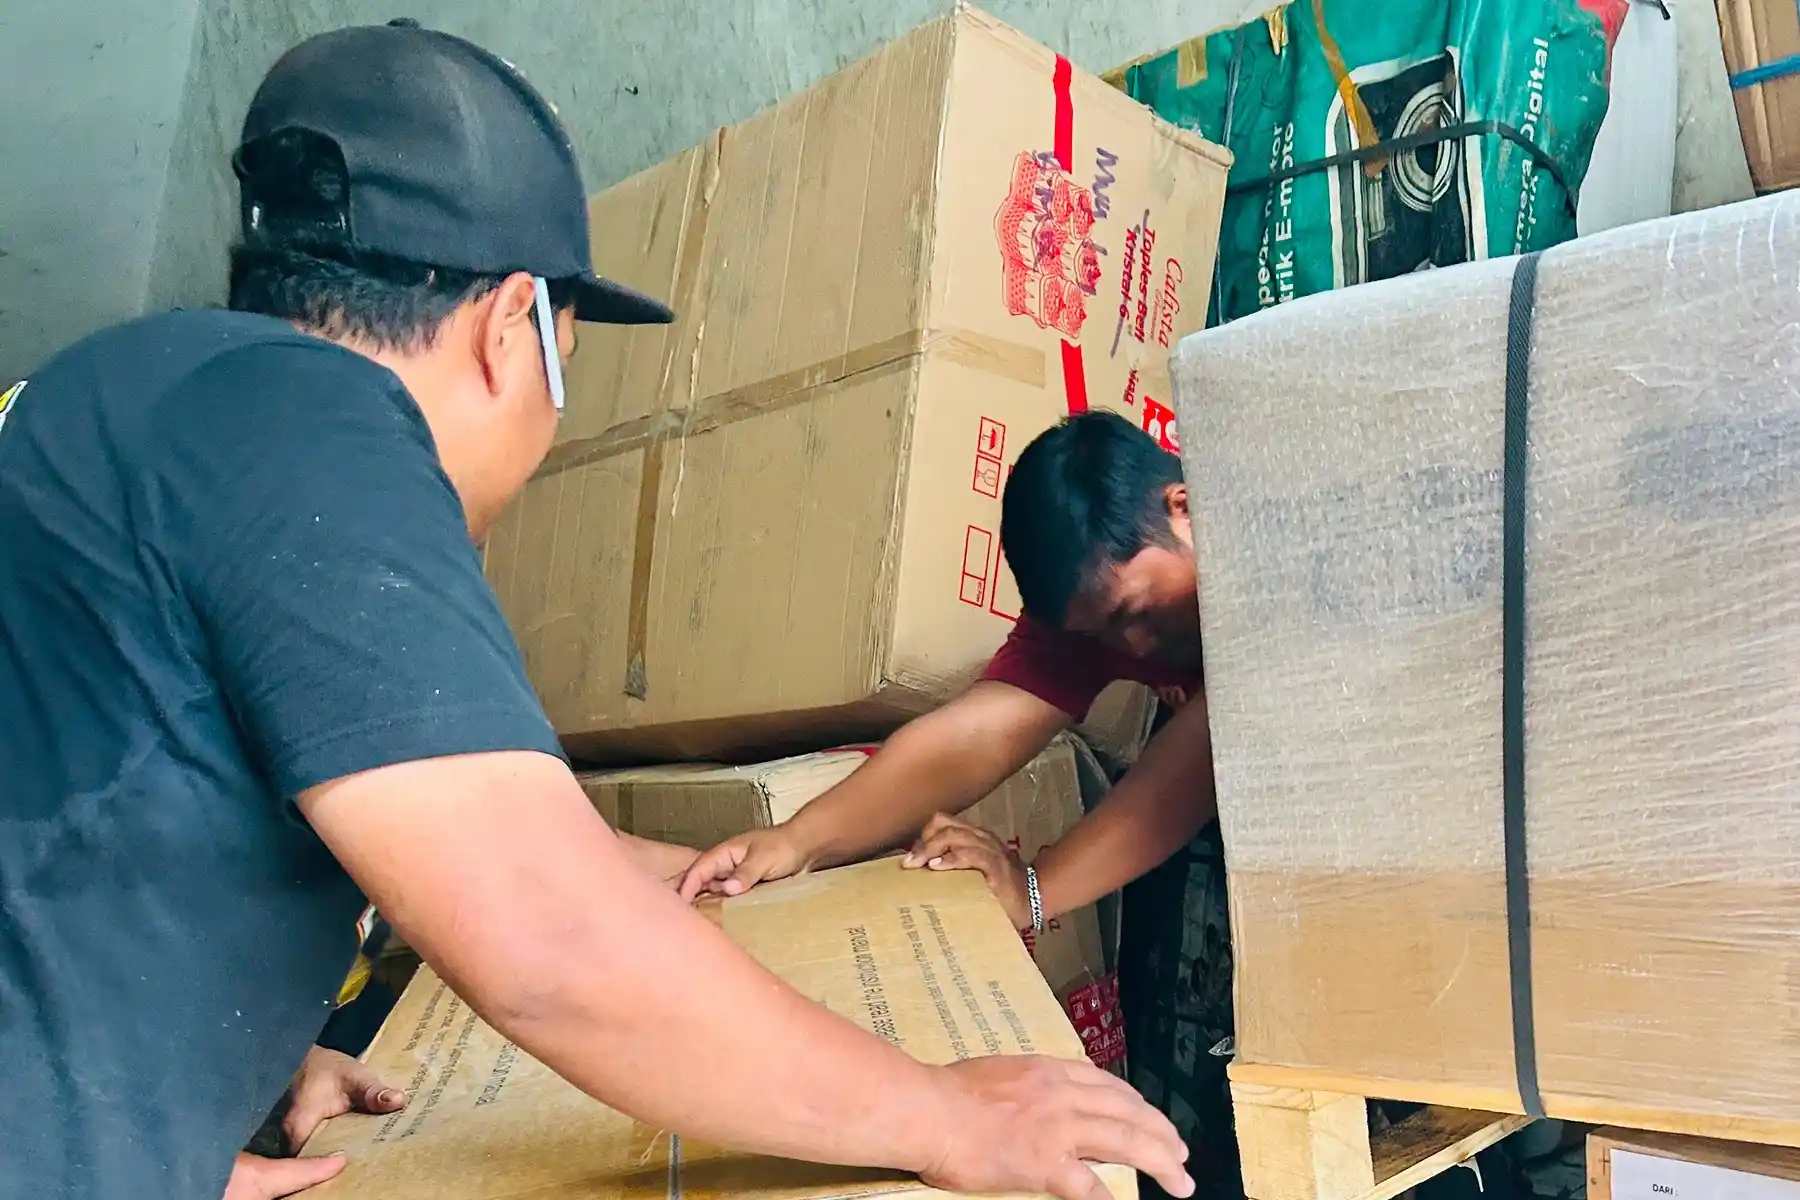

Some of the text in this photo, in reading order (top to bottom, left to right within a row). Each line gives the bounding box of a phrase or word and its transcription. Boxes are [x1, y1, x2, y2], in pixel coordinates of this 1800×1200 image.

[1519, 37, 1549, 143] Digital
[1118, 227, 1138, 321] Kristal 6
[1137, 227, 1156, 295] Toples
[1158, 257, 1184, 350] Calista
[1652, 1183, 1674, 1196] DARI
